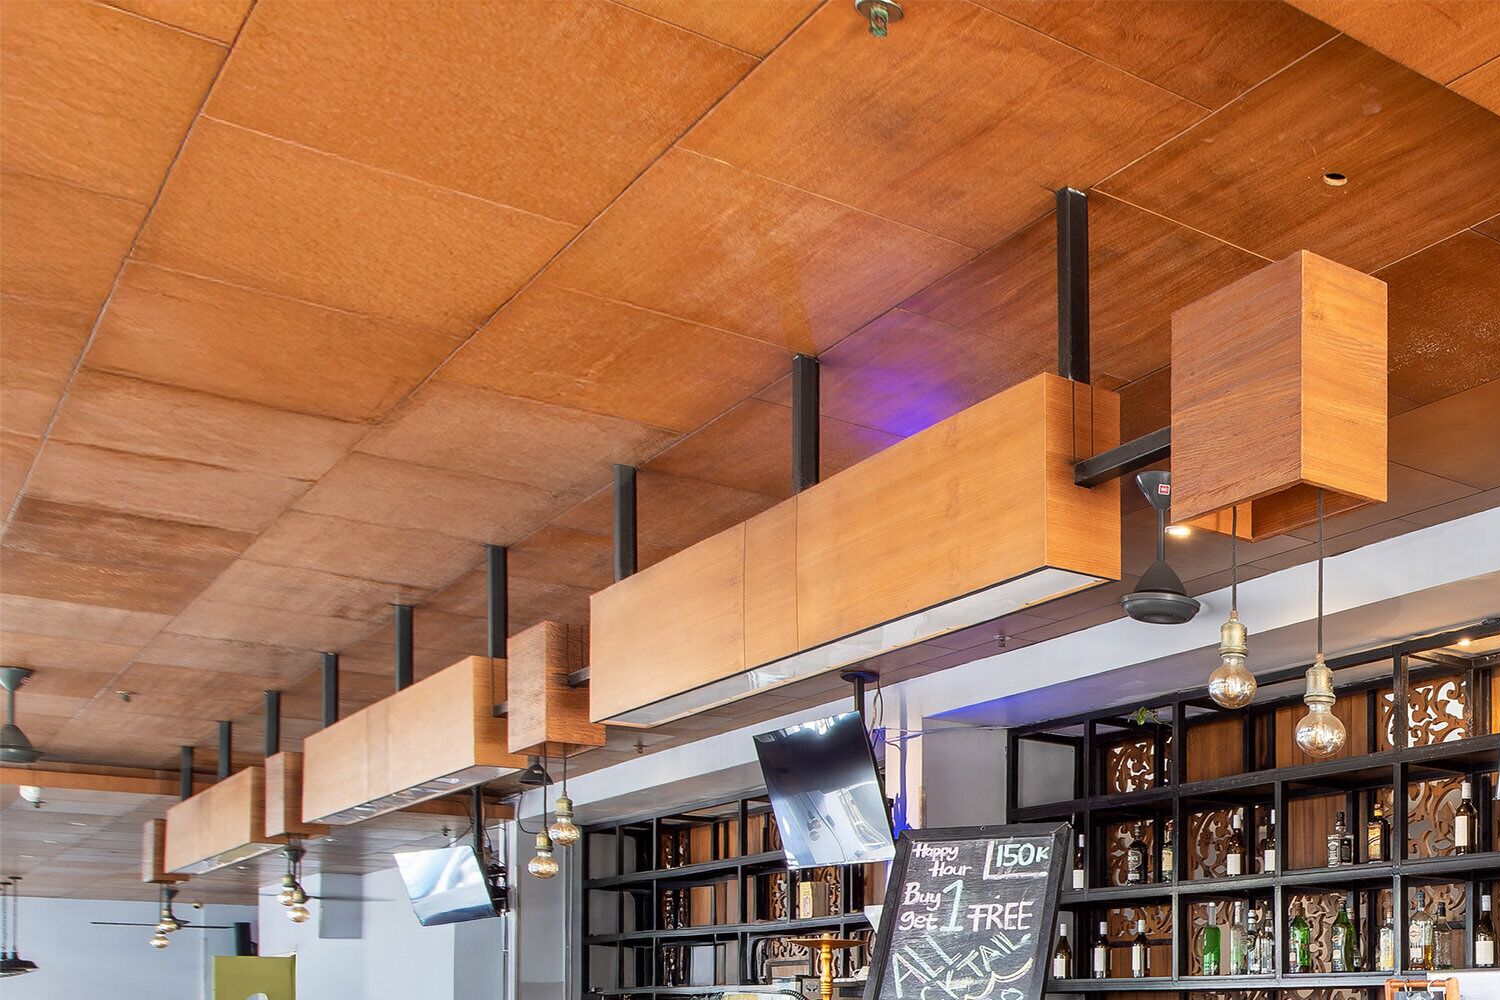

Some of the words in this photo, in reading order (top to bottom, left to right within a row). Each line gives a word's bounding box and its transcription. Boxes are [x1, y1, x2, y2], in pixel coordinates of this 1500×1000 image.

[912, 843, 959, 861] Happy
[928, 860, 973, 878] Hour
[898, 911, 938, 931] get
[967, 900, 1035, 932] FREE
[903, 881, 942, 911] Buy
[942, 880, 964, 932] 1
[892, 934, 963, 999] ALL
